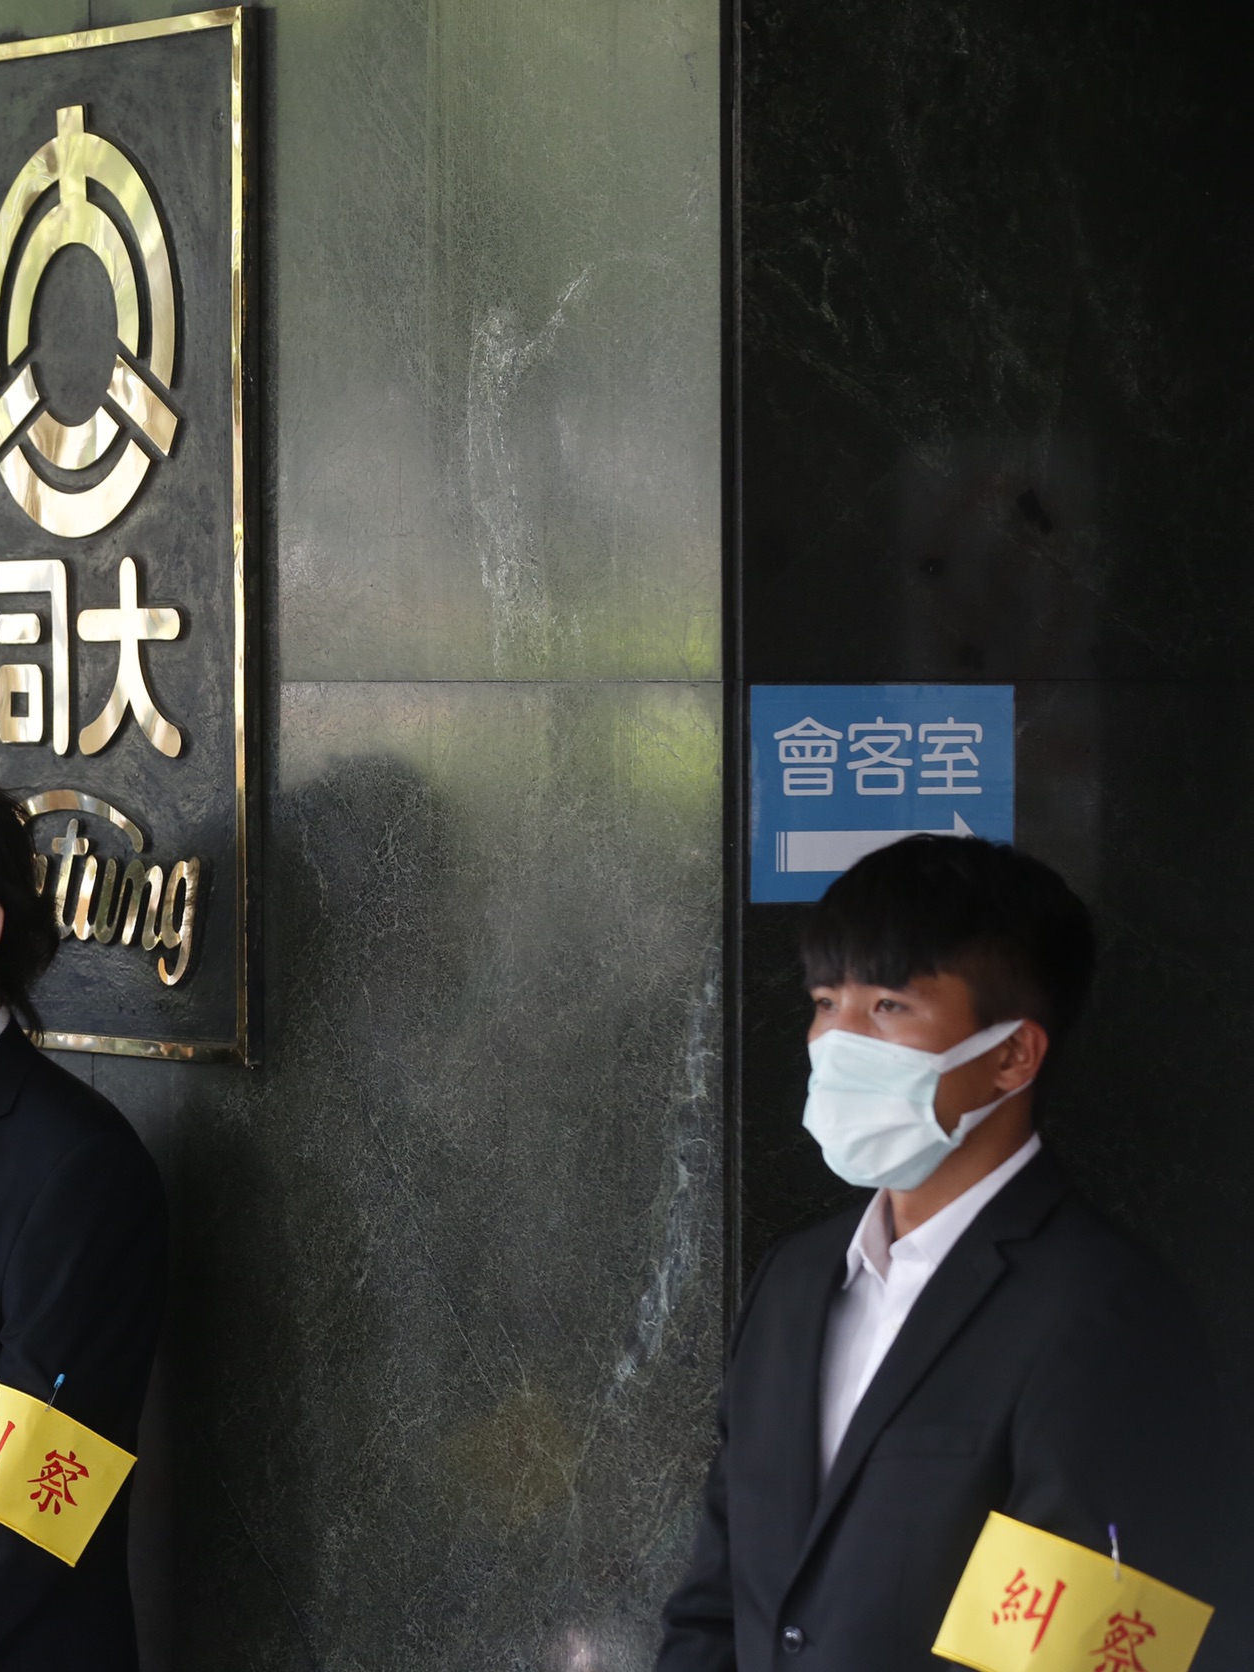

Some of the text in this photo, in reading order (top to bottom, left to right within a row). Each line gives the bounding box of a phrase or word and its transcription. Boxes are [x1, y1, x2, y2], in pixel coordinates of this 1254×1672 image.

[773, 716, 983, 796] 會客室
[992, 1568, 1157, 1672] 糾察
